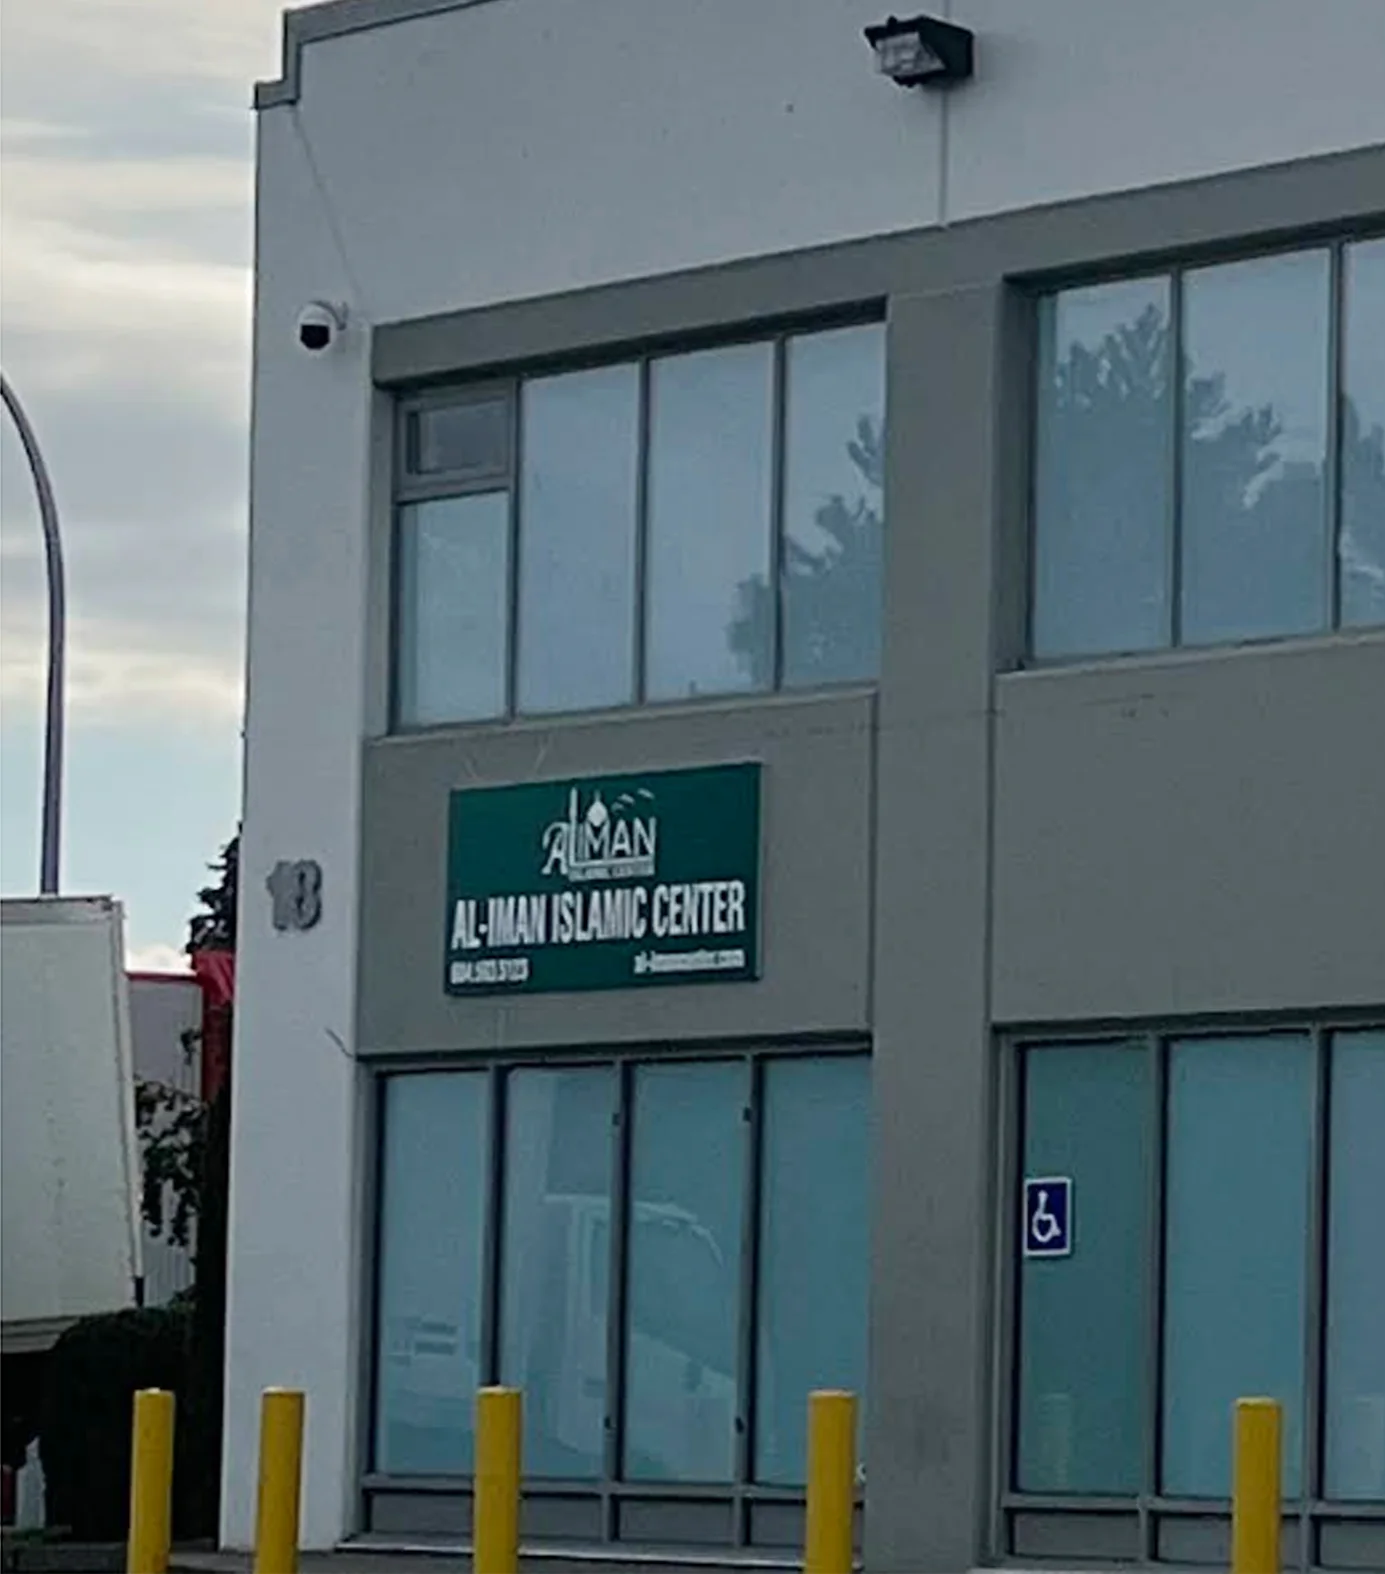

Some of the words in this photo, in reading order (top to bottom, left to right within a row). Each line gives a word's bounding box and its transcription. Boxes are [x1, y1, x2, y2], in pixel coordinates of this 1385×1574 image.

[266, 859, 322, 931] 18
[451, 893, 547, 950] AL-IMAN
[551, 885, 648, 944] ISLAMIC
[652, 879, 746, 938] CENTER
